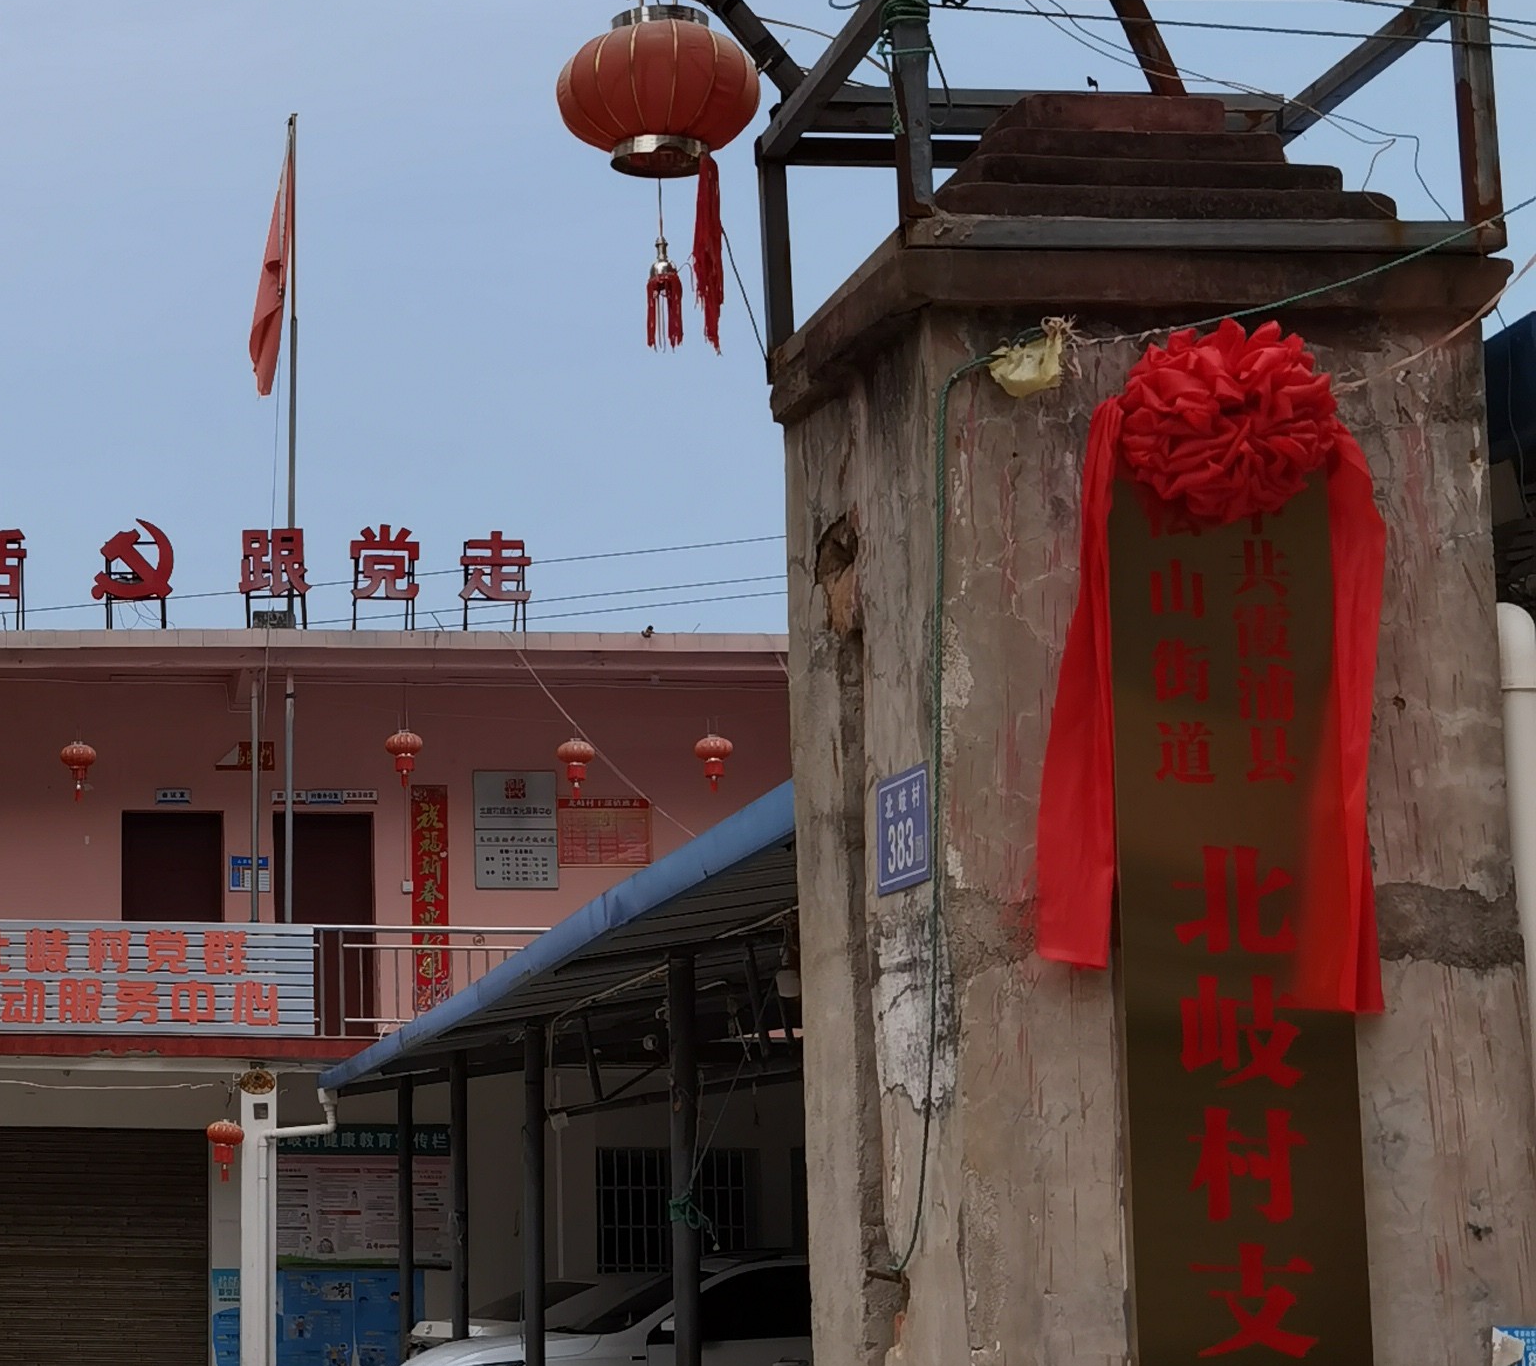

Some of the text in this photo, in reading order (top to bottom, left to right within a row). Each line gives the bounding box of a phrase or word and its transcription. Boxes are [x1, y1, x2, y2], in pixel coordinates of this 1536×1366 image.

[239, 524, 533, 602] 跟党走
[1148, 507, 1217, 785] 山街道
[1230, 510, 1300, 785] 共霞浦县
[885, 780, 921, 819] 北岐村
[887, 817, 914, 874] 383
[277, 1131, 449, 1149] 岐村健康教育传栏
